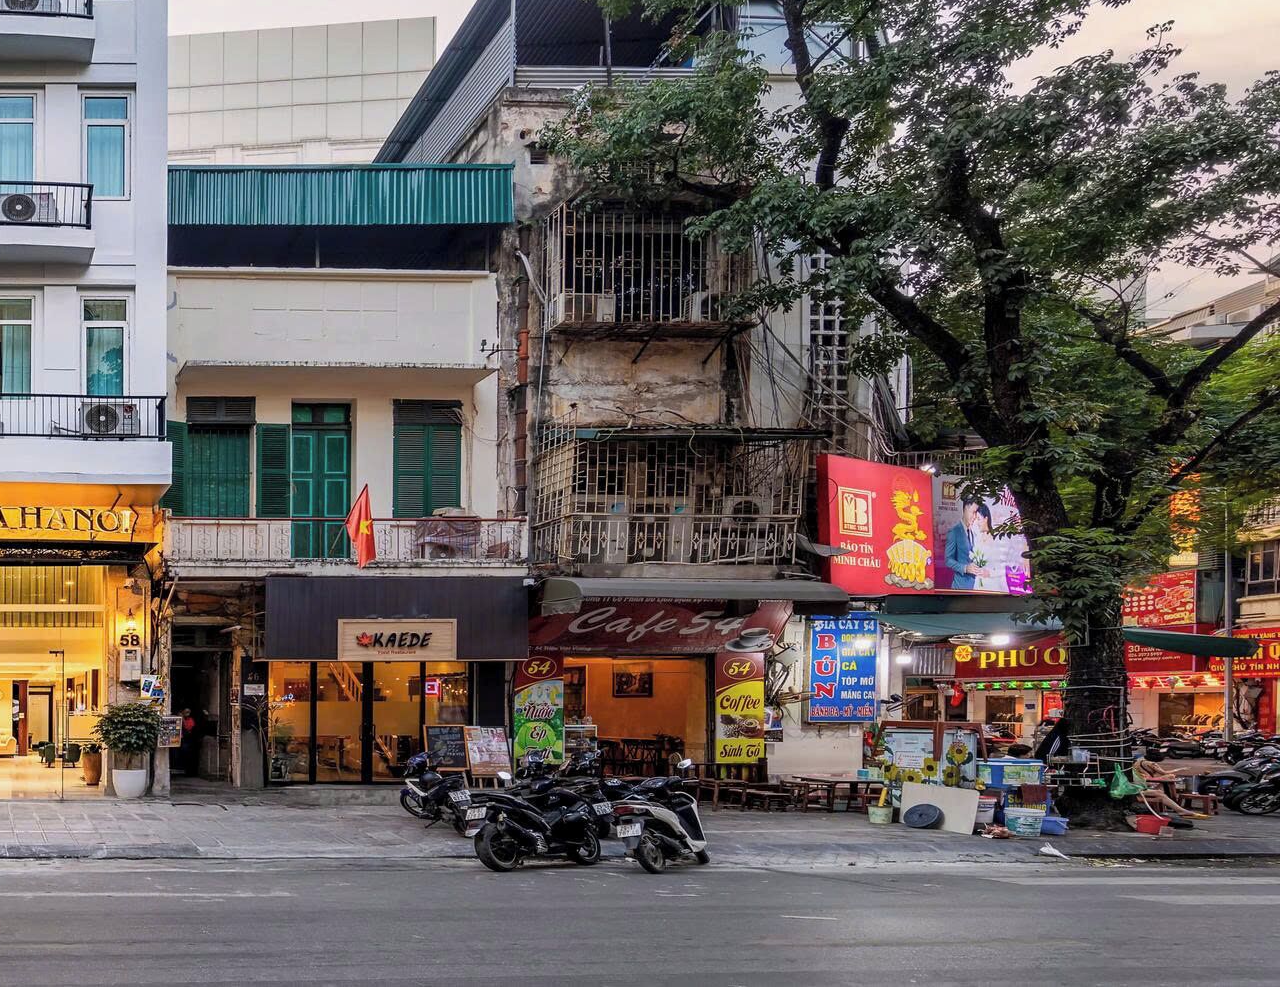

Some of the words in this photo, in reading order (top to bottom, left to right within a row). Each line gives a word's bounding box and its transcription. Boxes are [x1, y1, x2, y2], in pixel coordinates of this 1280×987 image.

[19, 506, 132, 533] HANOI
[859, 542, 874, 554] TÍN
[833, 556, 856, 566] MINH
[858, 557, 881, 568] CHÂU
[568, 607, 680, 642] Cafe
[680, 611, 745, 636] 54
[120, 634, 140, 646] 58
[373, 632, 432, 648] KAEDE
[979, 646, 1040, 669] PHÚ
[1128, 645, 1140, 653] 30
[530, 660, 551, 674] 54
[729, 661, 751, 675] 54
[524, 702, 555, 720] Nước
[719, 694, 761, 716] Coffee
[530, 722, 547, 742] Ép
[719, 743, 743, 759] Sinh
[746, 741, 761, 759] Tố
